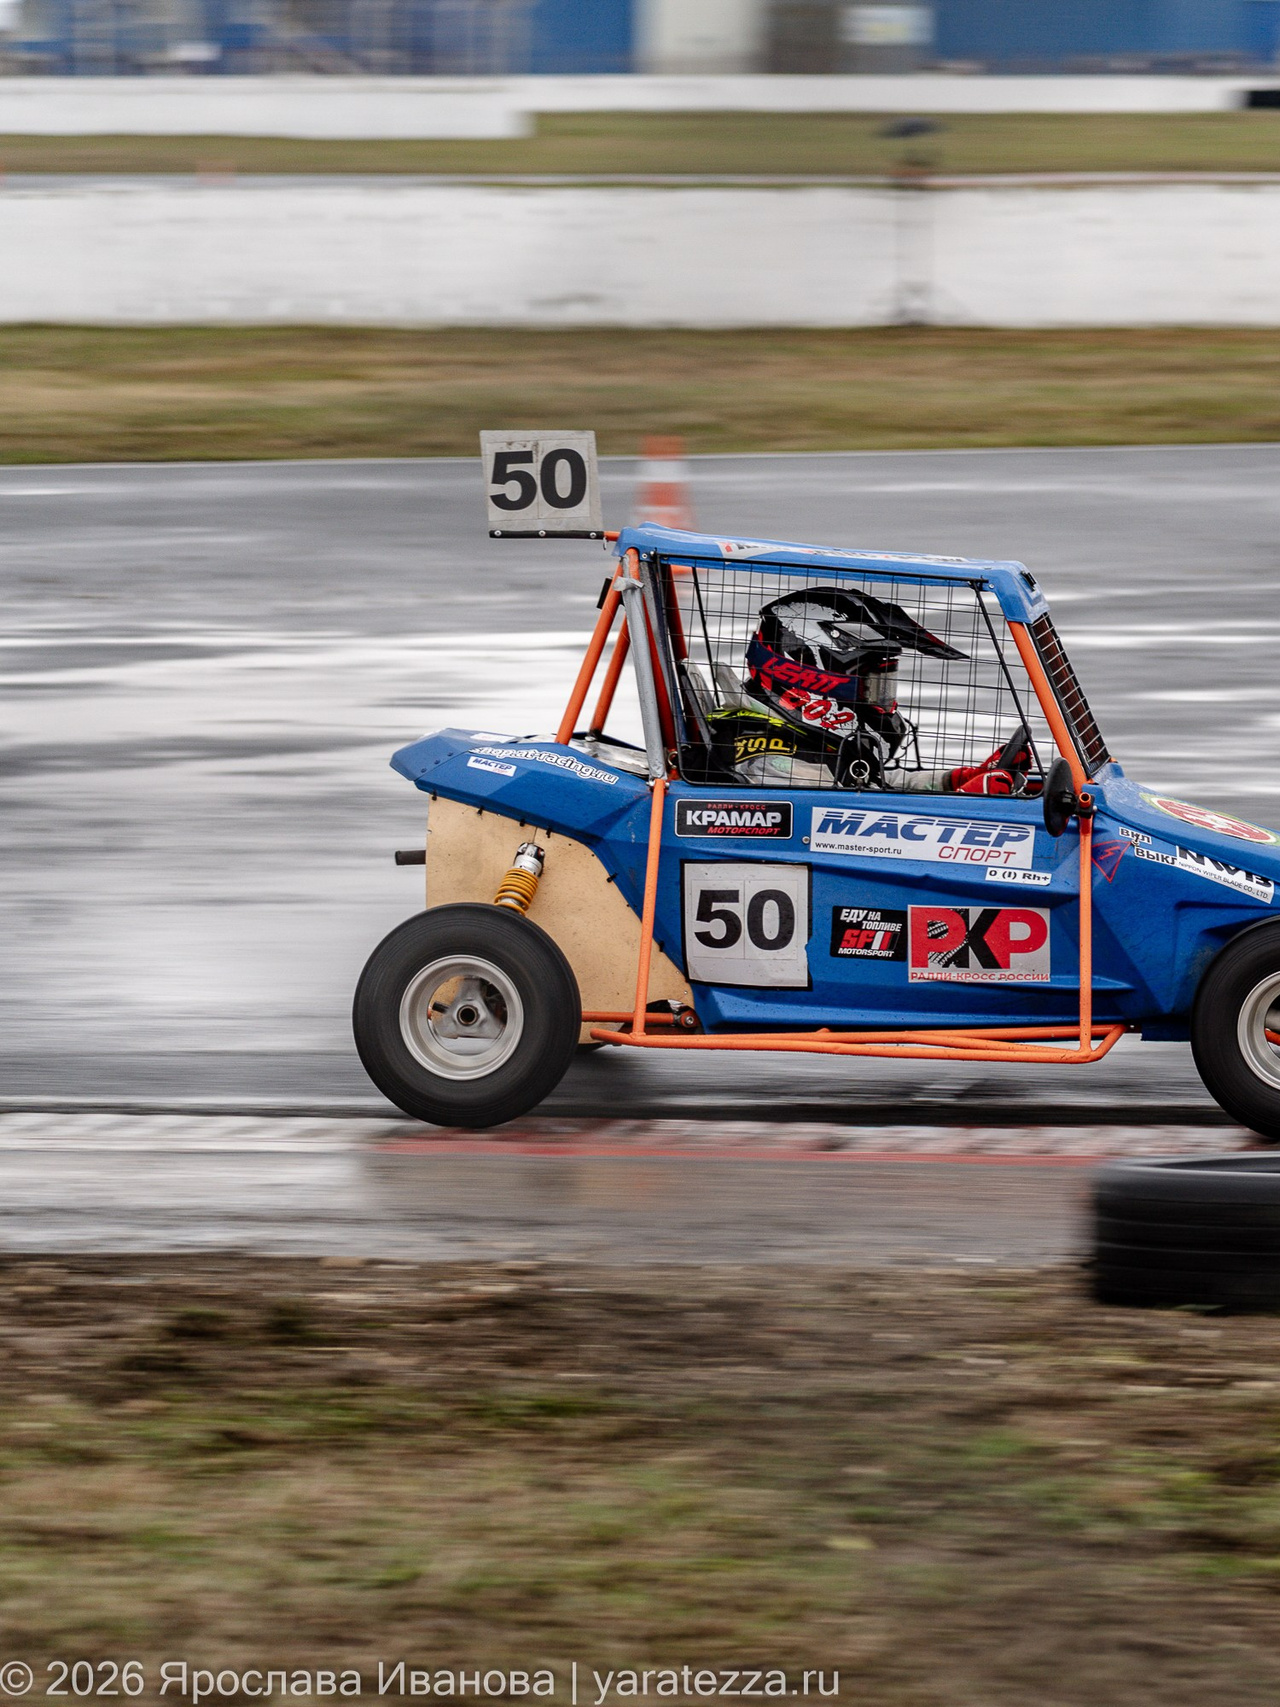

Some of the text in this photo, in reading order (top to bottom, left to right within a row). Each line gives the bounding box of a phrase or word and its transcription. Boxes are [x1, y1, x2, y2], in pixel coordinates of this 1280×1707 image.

[489, 448, 587, 511] 50
[472, 758, 512, 771] МАСТЕР
[686, 810, 782, 827] КРАМАР
[707, 826, 780, 835] МОТОРСПОРТ
[816, 811, 1031, 848] МАСТЕР
[815, 841, 902, 855] www.master-sport.ru
[938, 846, 1016, 864] СПОРТ
[1022, 872, 1049, 881] Rh+
[1203, 870, 1222, 881] WIPER
[1222, 877, 1242, 890] BLADE
[694, 889, 796, 951] 50
[840, 908, 881, 923] ЕДУ НА
[862, 920, 903, 931] ТОПЛИВЕ
[838, 947, 895, 957] MOTORSPORT
[911, 972, 1049, 981] РАЛЛИ-КРОСС РОССИИ
